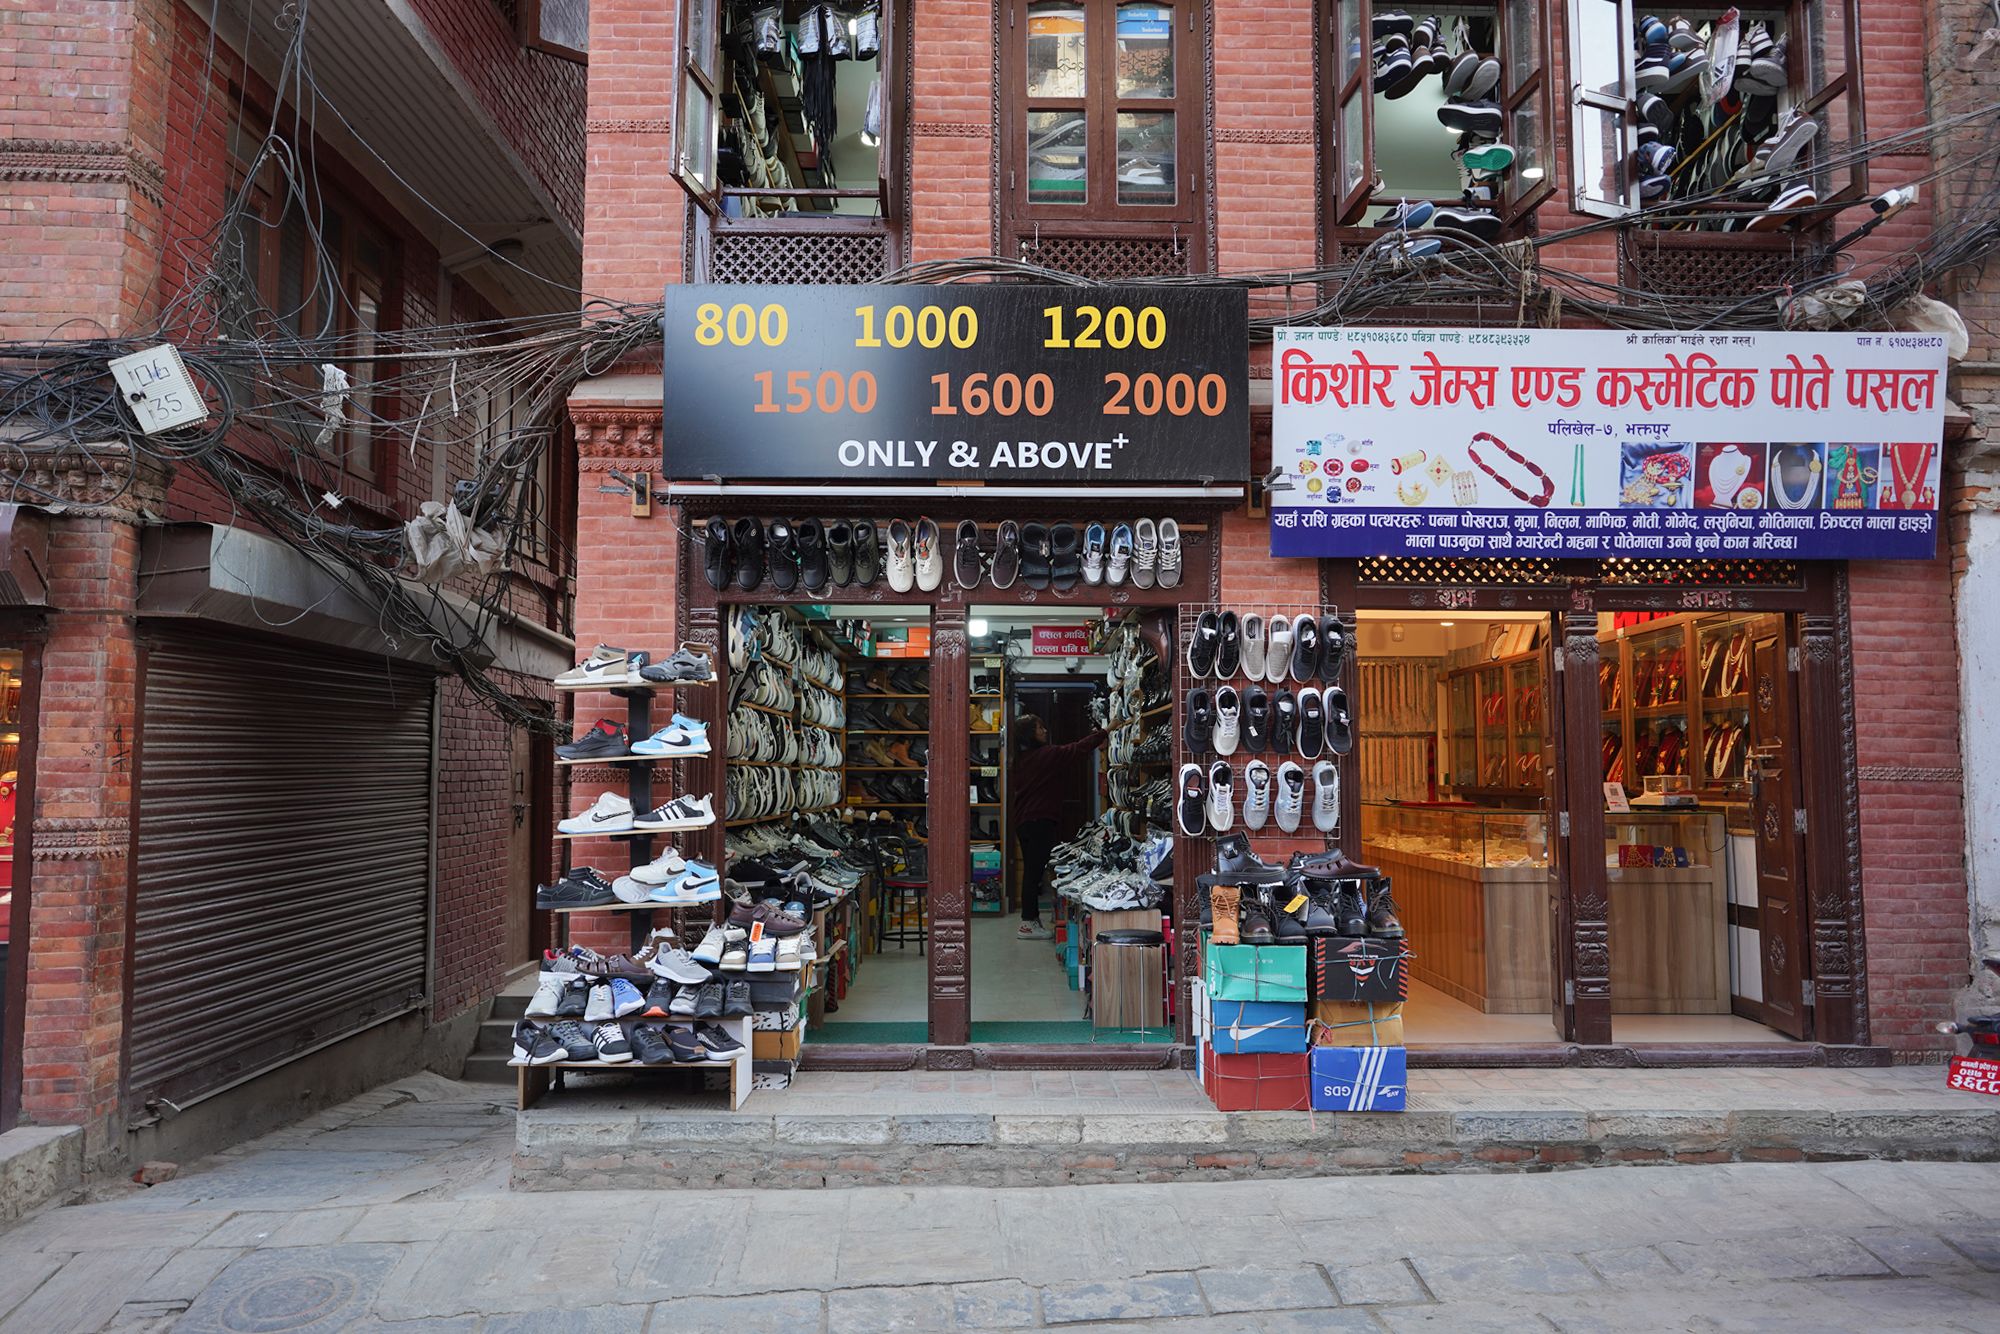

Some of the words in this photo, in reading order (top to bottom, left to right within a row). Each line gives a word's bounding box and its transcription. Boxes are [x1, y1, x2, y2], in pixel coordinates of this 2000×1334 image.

[696, 304, 787, 346] 800
[856, 306, 978, 348] 1000
[1043, 306, 1166, 349] 1200
[1294, 331, 1314, 341] जगत
[1626, 333, 1638, 345] श्री
[1642, 333, 1676, 345] कालिका
[1709, 336, 1728, 346] रक्षा
[1281, 349, 1399, 408] किशोर
[1411, 351, 1499, 409] जेम्स
[1511, 366, 1586, 407] एण्ड
[1597, 353, 1759, 411] कस्मेटिक
[1771, 354, 1834, 411] पोते
[1846, 369, 1938, 411] पसल
[754, 371, 877, 413] 1500
[931, 373, 1054, 416] 1600
[1103, 373, 1227, 416] 2000
[149, 391, 183, 421] 35
[1626, 424, 1671, 440] भक्तपुर
[837, 440, 937, 467] ONLY
[948, 441, 980, 468] &
[1275, 510, 1298, 528] यहाँ
[1302, 510, 1328, 528] राशि
[1331, 514, 1366, 528] ग्रहका
[1429, 515, 1458, 528] पन्ना
[1867, 516, 1896, 529] माला
[1406, 535, 1435, 548] माला
[1439, 535, 1485, 551] पाउनुका
[1488, 531, 1513, 549] साथै
[1516, 532, 1564, 549] ग्यारेन्टी
[1567, 535, 1599, 550] गहना
[1602, 536, 1611, 549] र
[1614, 532, 1663, 549] पोतेमाला
[1667, 532, 1692, 549] उन्ने
[1695, 532, 1721, 552] बुन्ने
[1724, 535, 1749, 549] काम
[1324, 1086, 1352, 1098] GDS
